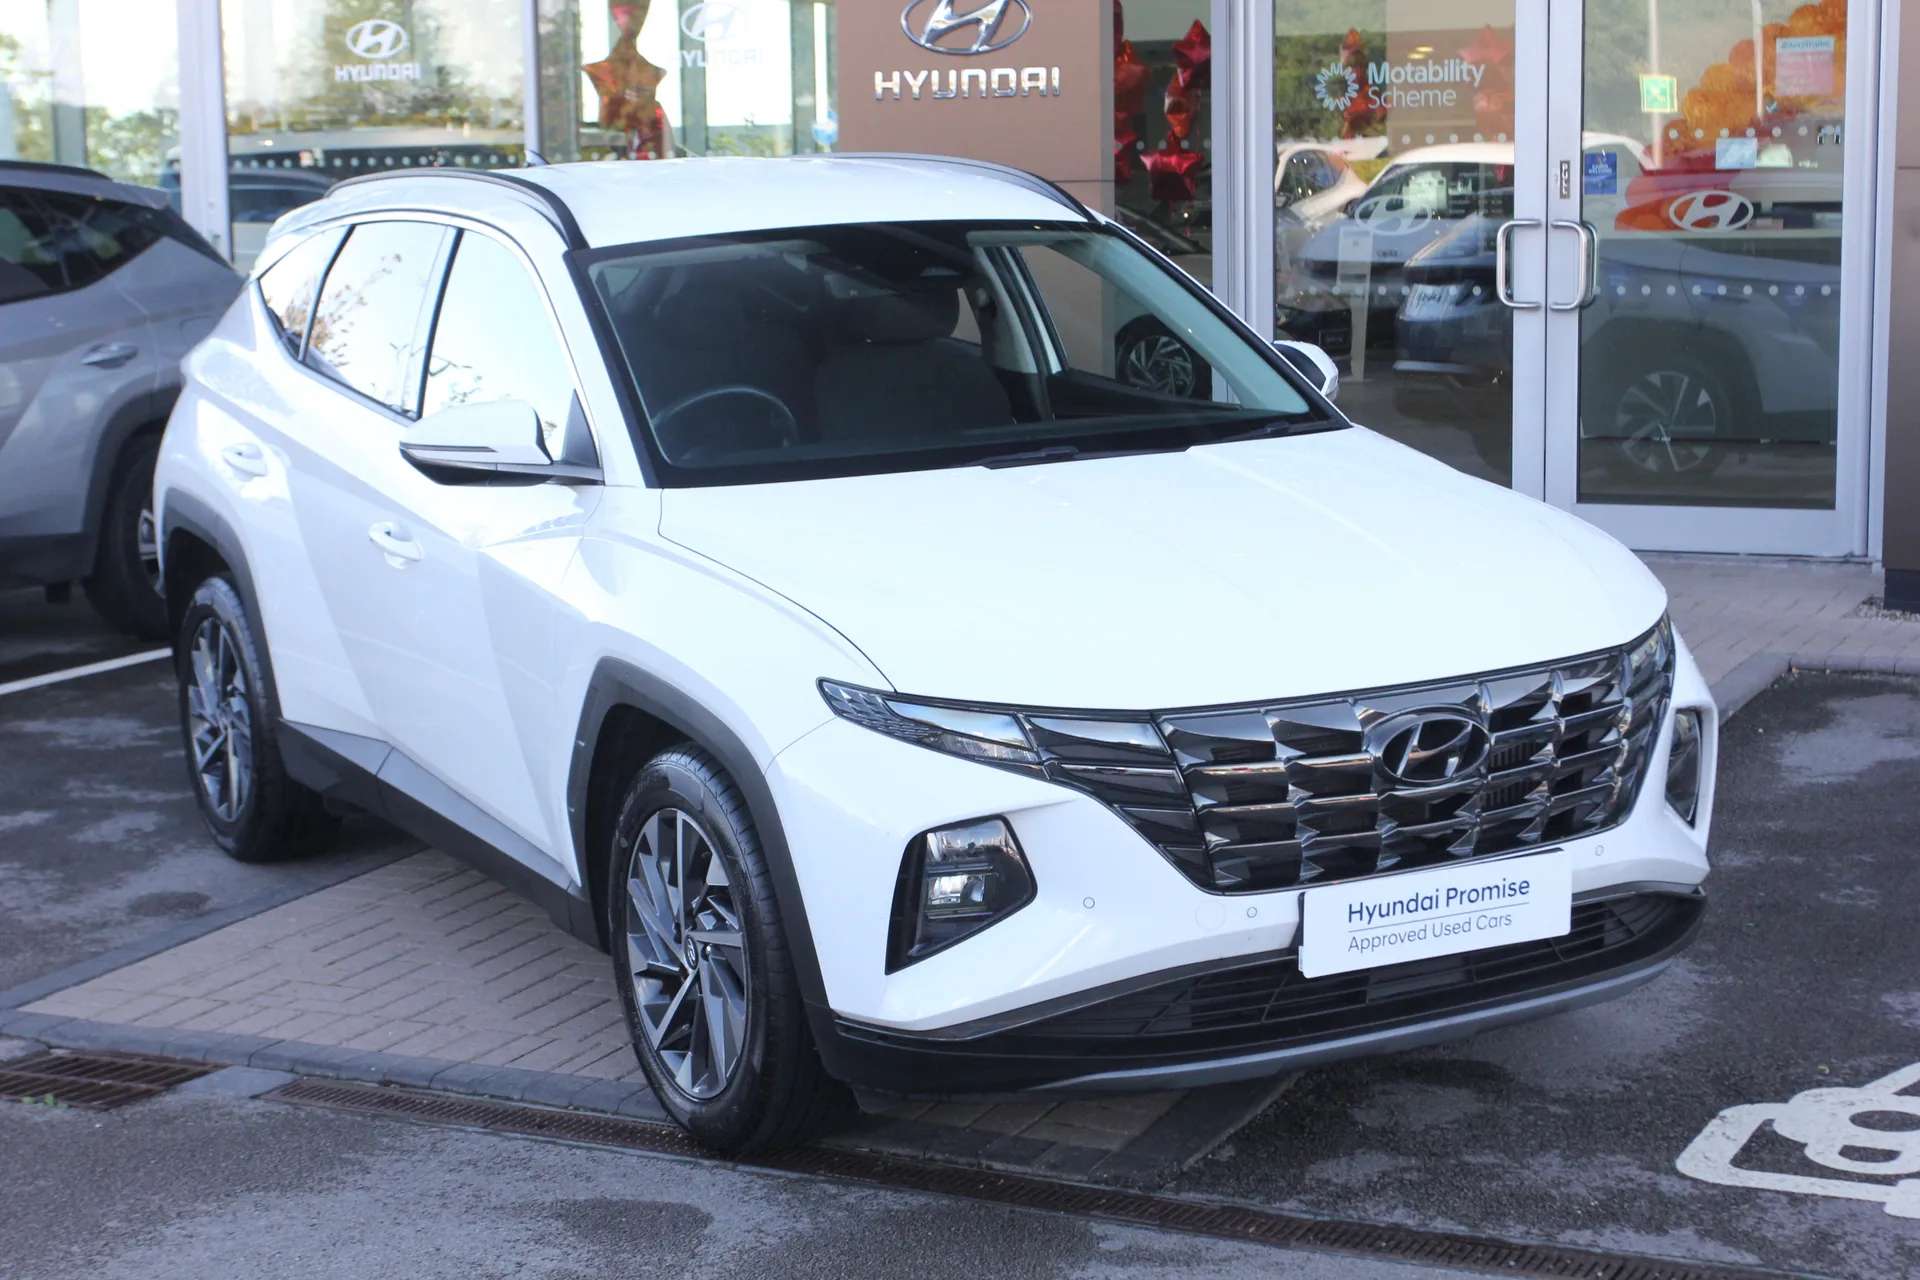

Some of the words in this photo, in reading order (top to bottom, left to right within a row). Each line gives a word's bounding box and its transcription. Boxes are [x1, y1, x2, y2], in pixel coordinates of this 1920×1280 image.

[334, 63, 421, 82] HYUNDAI
[873, 66, 1060, 101] HYUNDAI
[1368, 58, 1487, 88] Motability
[1368, 86, 1457, 109] Scheme
[1348, 888, 1440, 925] Hyundai
[1445, 877, 1531, 908] Promise
[1347, 924, 1428, 954] Approved
[1431, 916, 1472, 940] Used
[1475, 911, 1513, 932] Cars
